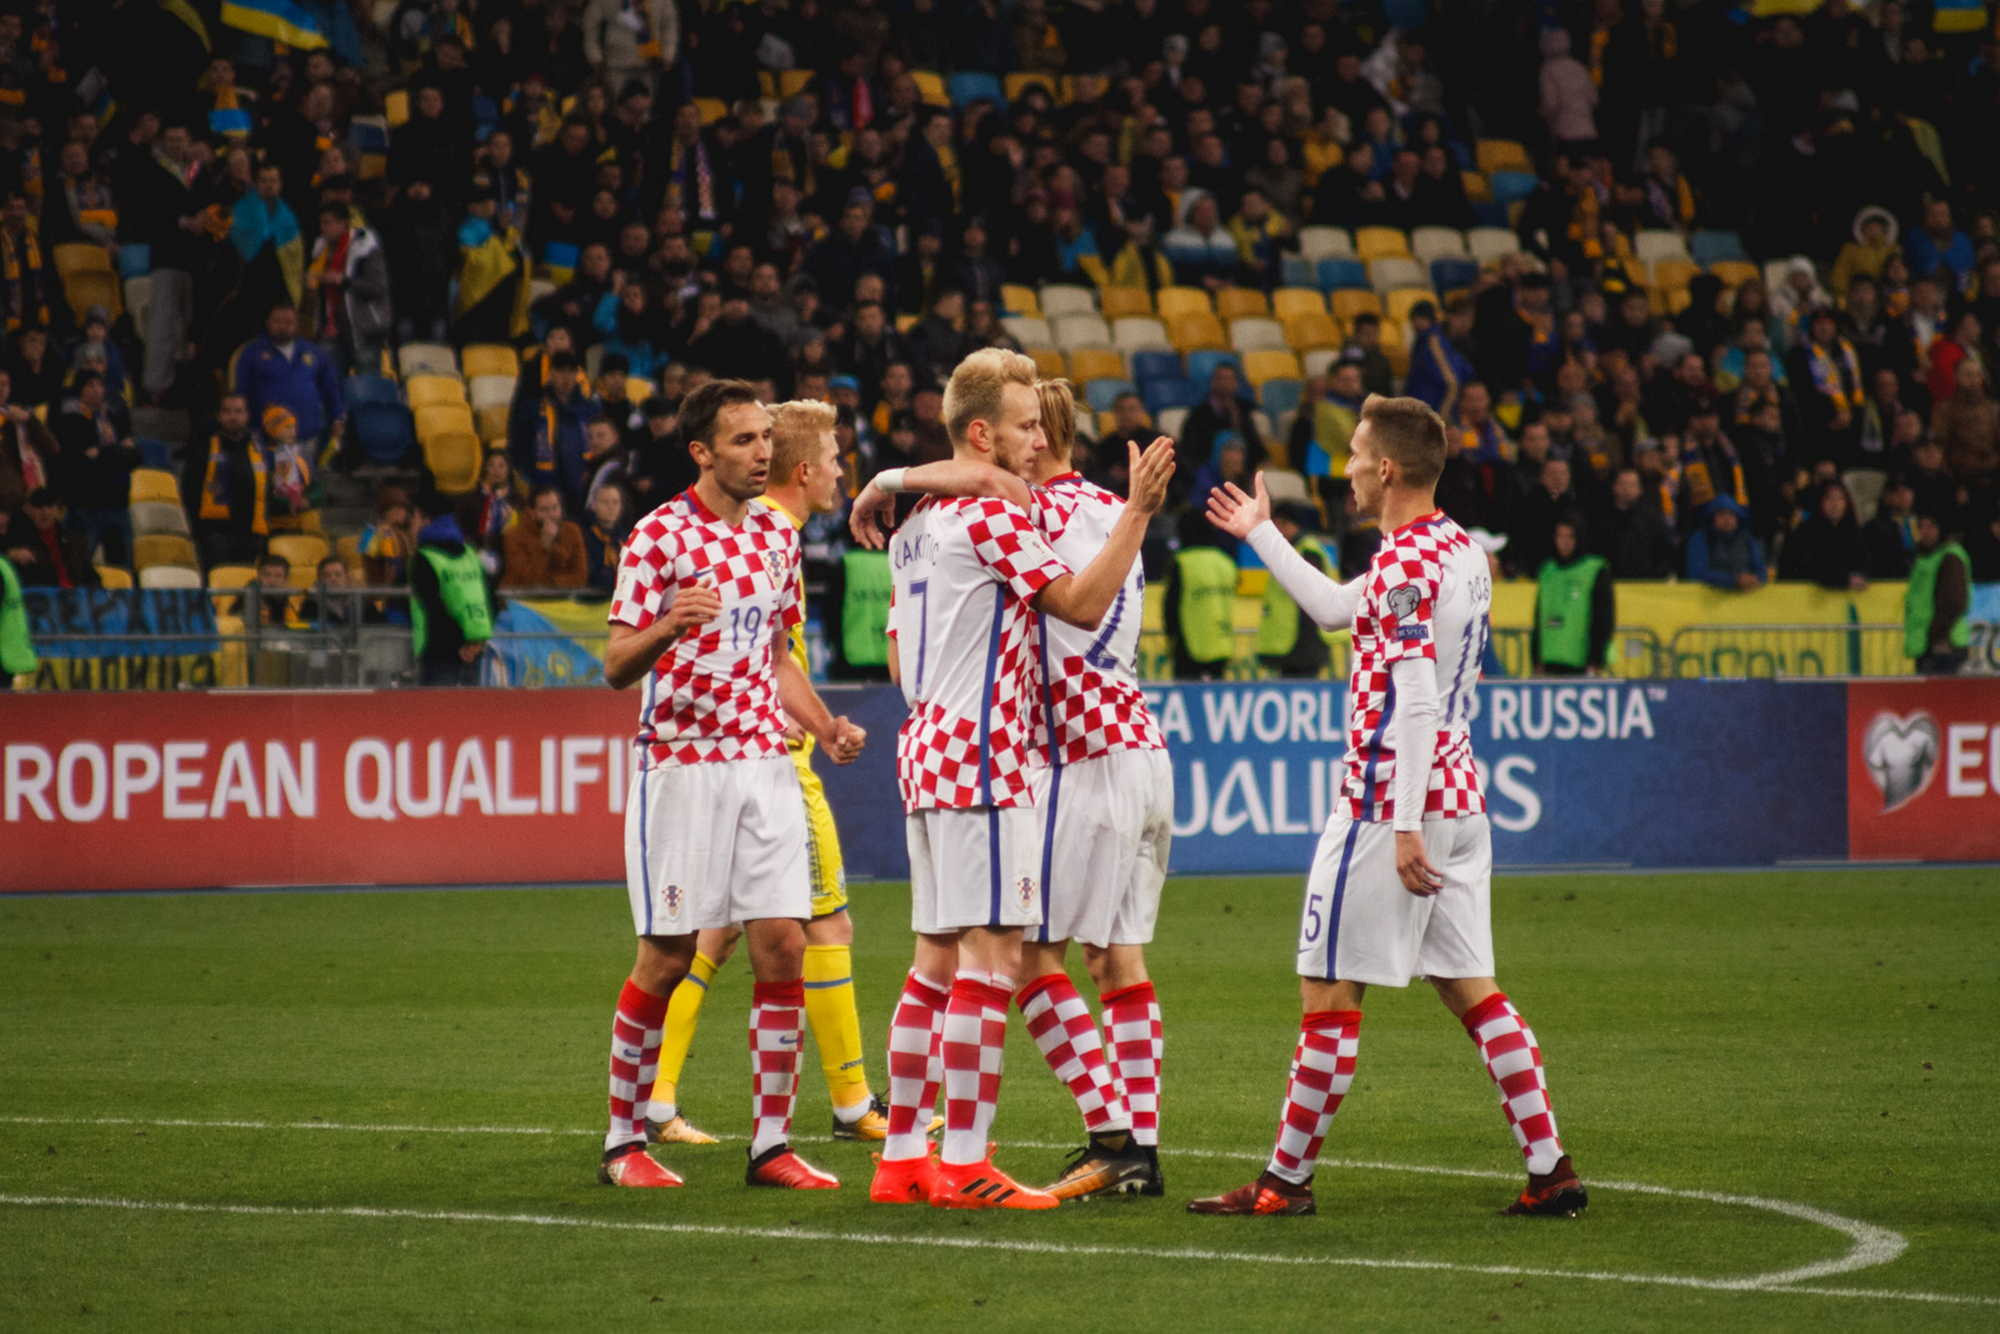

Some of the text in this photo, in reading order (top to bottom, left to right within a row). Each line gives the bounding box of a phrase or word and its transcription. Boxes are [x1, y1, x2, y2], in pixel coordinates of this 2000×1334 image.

[730, 606, 762, 651] 19
[909, 579, 928, 695] 7
[1202, 690, 1350, 743] WORL
[4, 736, 635, 822] ROPEAN QUALIFI
